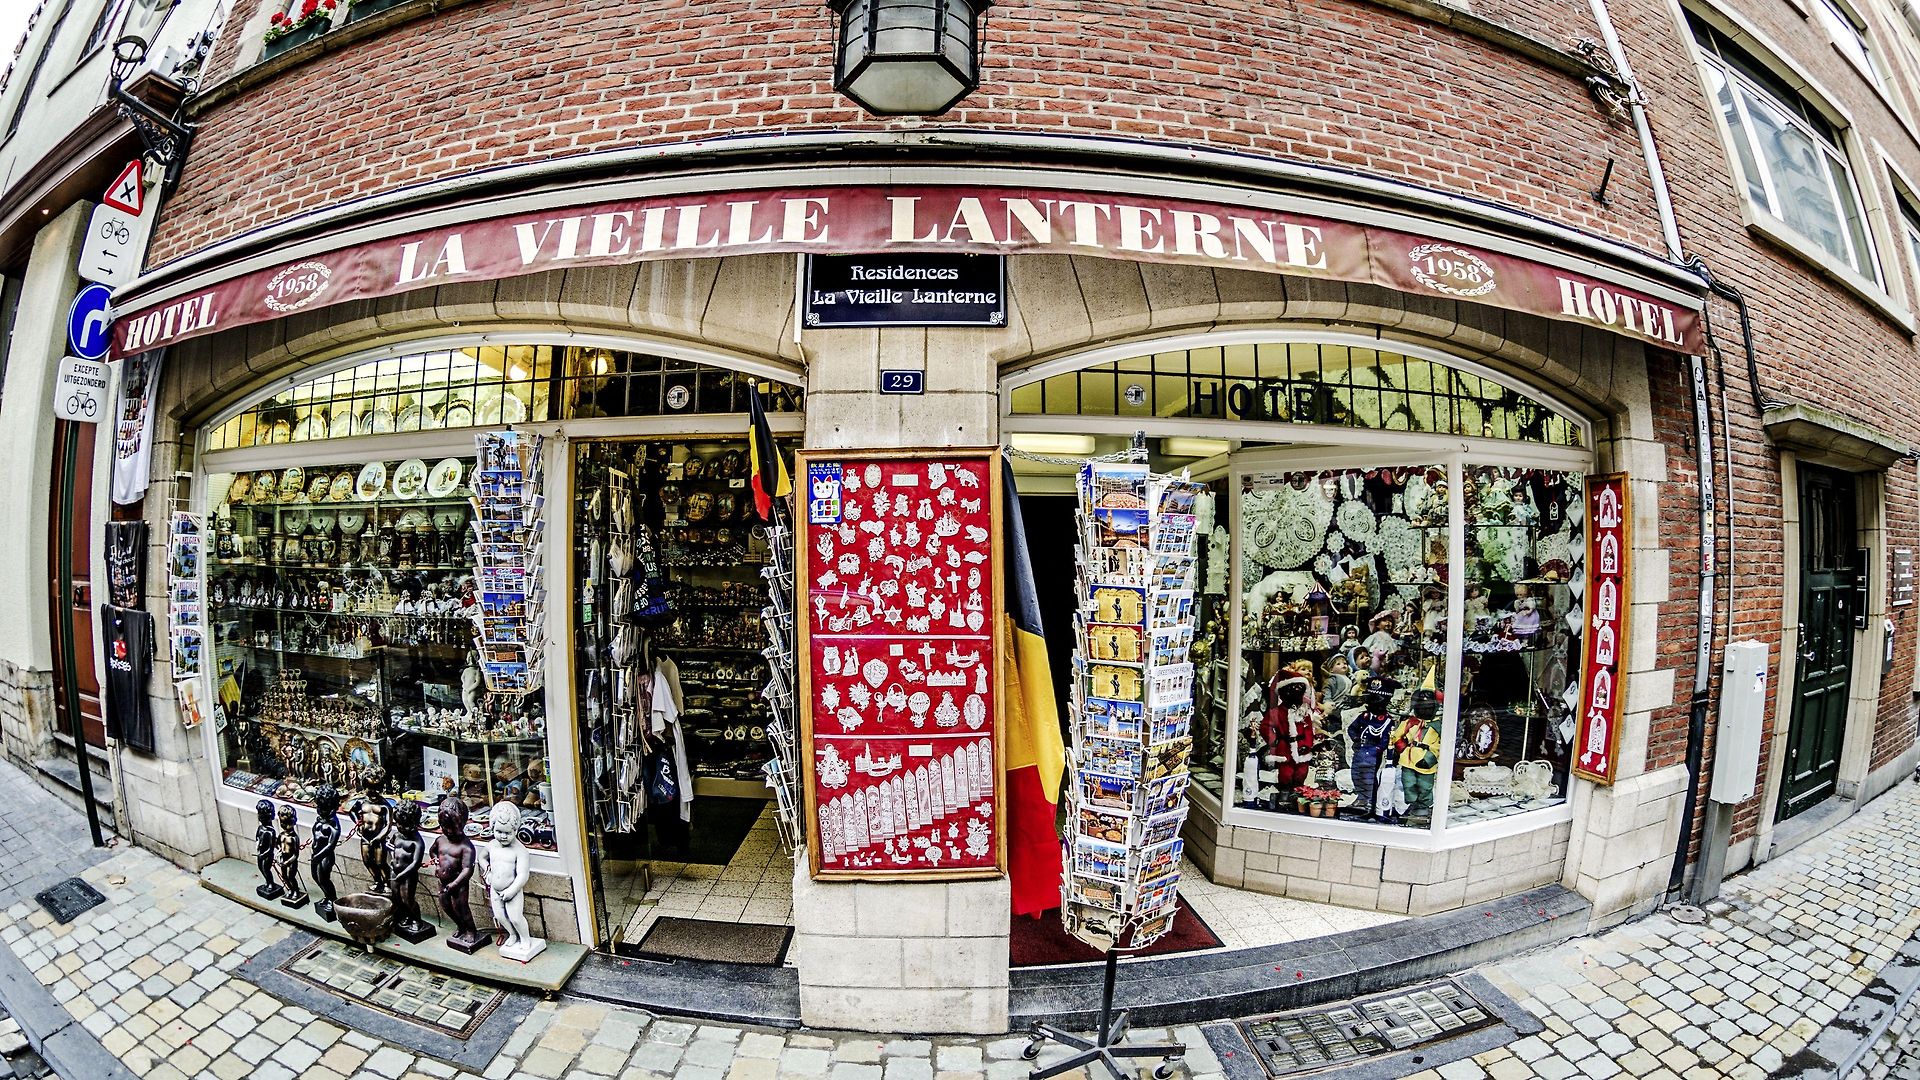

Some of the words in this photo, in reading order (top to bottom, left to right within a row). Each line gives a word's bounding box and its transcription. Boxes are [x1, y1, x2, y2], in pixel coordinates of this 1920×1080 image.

[395, 233, 468, 286] LA
[513, 196, 830, 266] VIEILLE
[885, 195, 1328, 270] LANTERNE
[850, 265, 959, 281] Residences
[1422, 255, 1483, 284] 1958
[275, 272, 319, 299] 1958
[812, 290, 836, 304] La
[845, 288, 903, 304] Vieille
[911, 288, 997, 304] Lanterne
[122, 291, 218, 352] HOTEL
[1556, 276, 1684, 346] HOTEL
[63, 374, 106, 389] UITGEZONDERD
[890, 374, 914, 388] 29
[1192, 381, 1346, 422] HOTEL
[1084, 773, 1131, 787] Bruxelles
